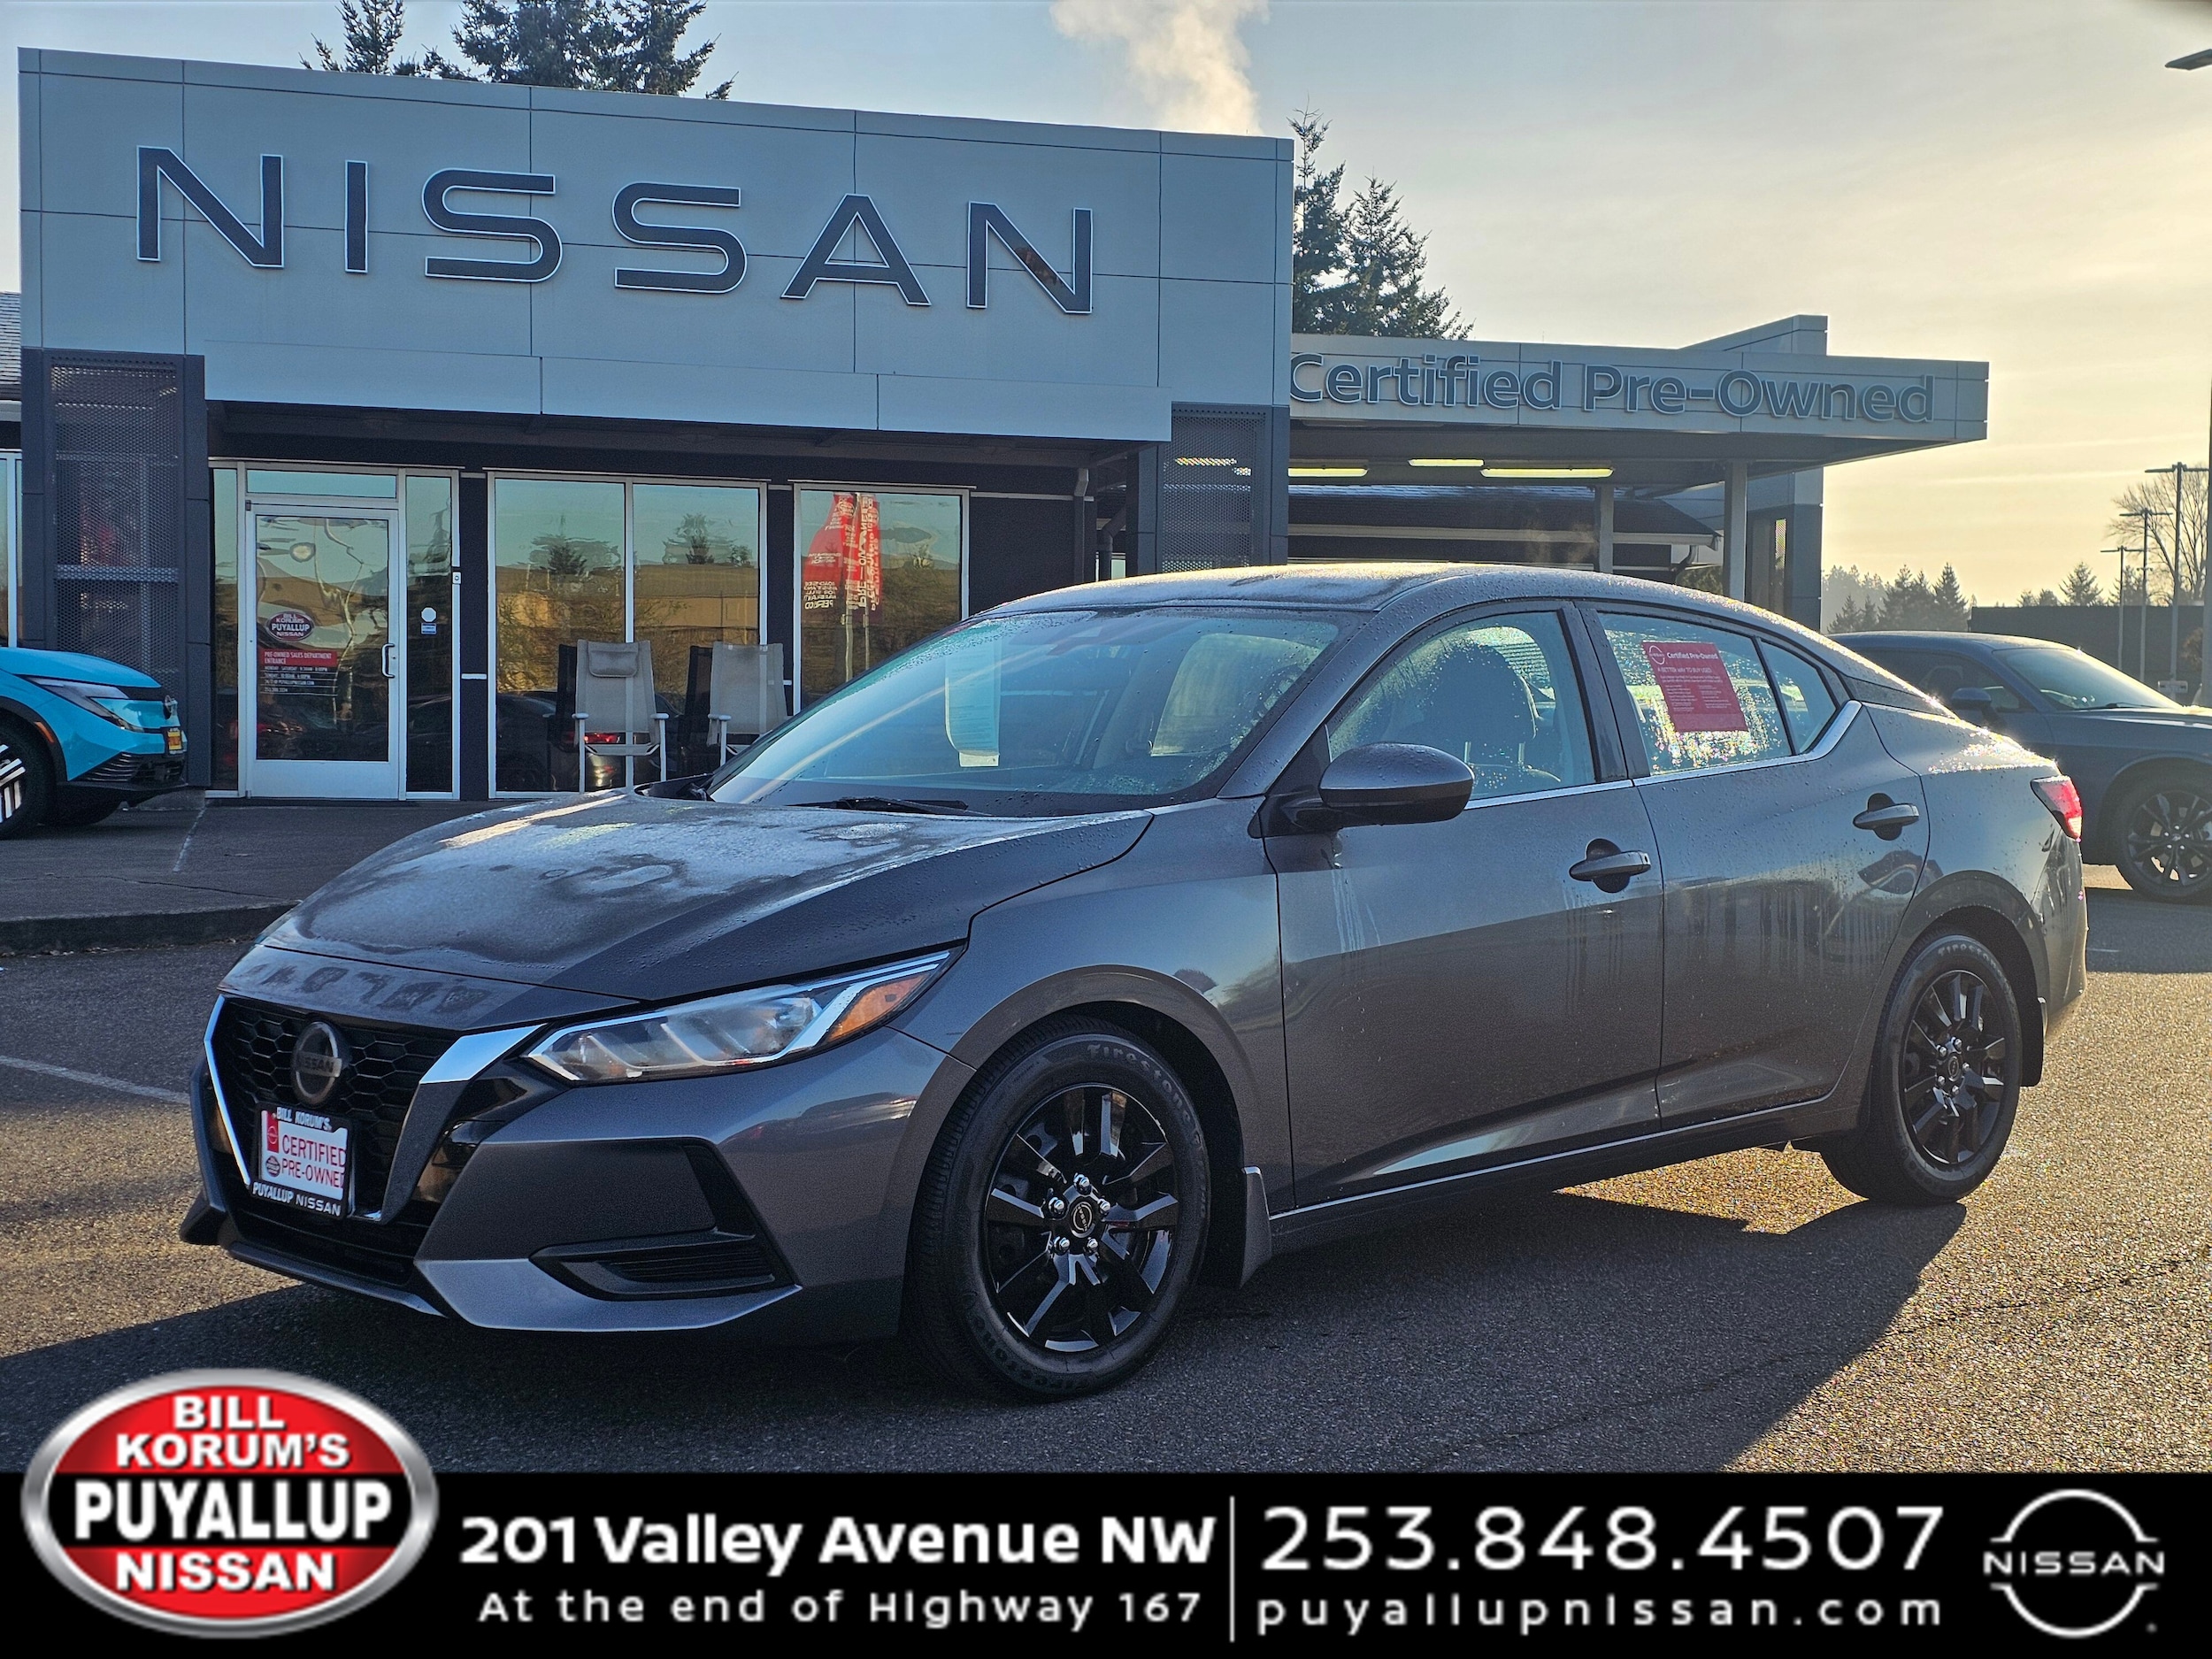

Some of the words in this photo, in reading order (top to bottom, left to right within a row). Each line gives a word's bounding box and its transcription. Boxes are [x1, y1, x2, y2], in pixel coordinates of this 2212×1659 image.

[136, 144, 1094, 314] NISSAN
[1290, 353, 1563, 411] Certified
[1582, 363, 1935, 423] Pre-Owned
[1087, 1043, 1192, 1124] Firestone
[276, 1106, 293, 1123] BILL
[295, 1111, 331, 1131] KORUM'S
[282, 1134, 347, 1168] CERTIFIED
[252, 1181, 295, 1203] PUYALLUP
[296, 1194, 342, 1217] NISSAN
